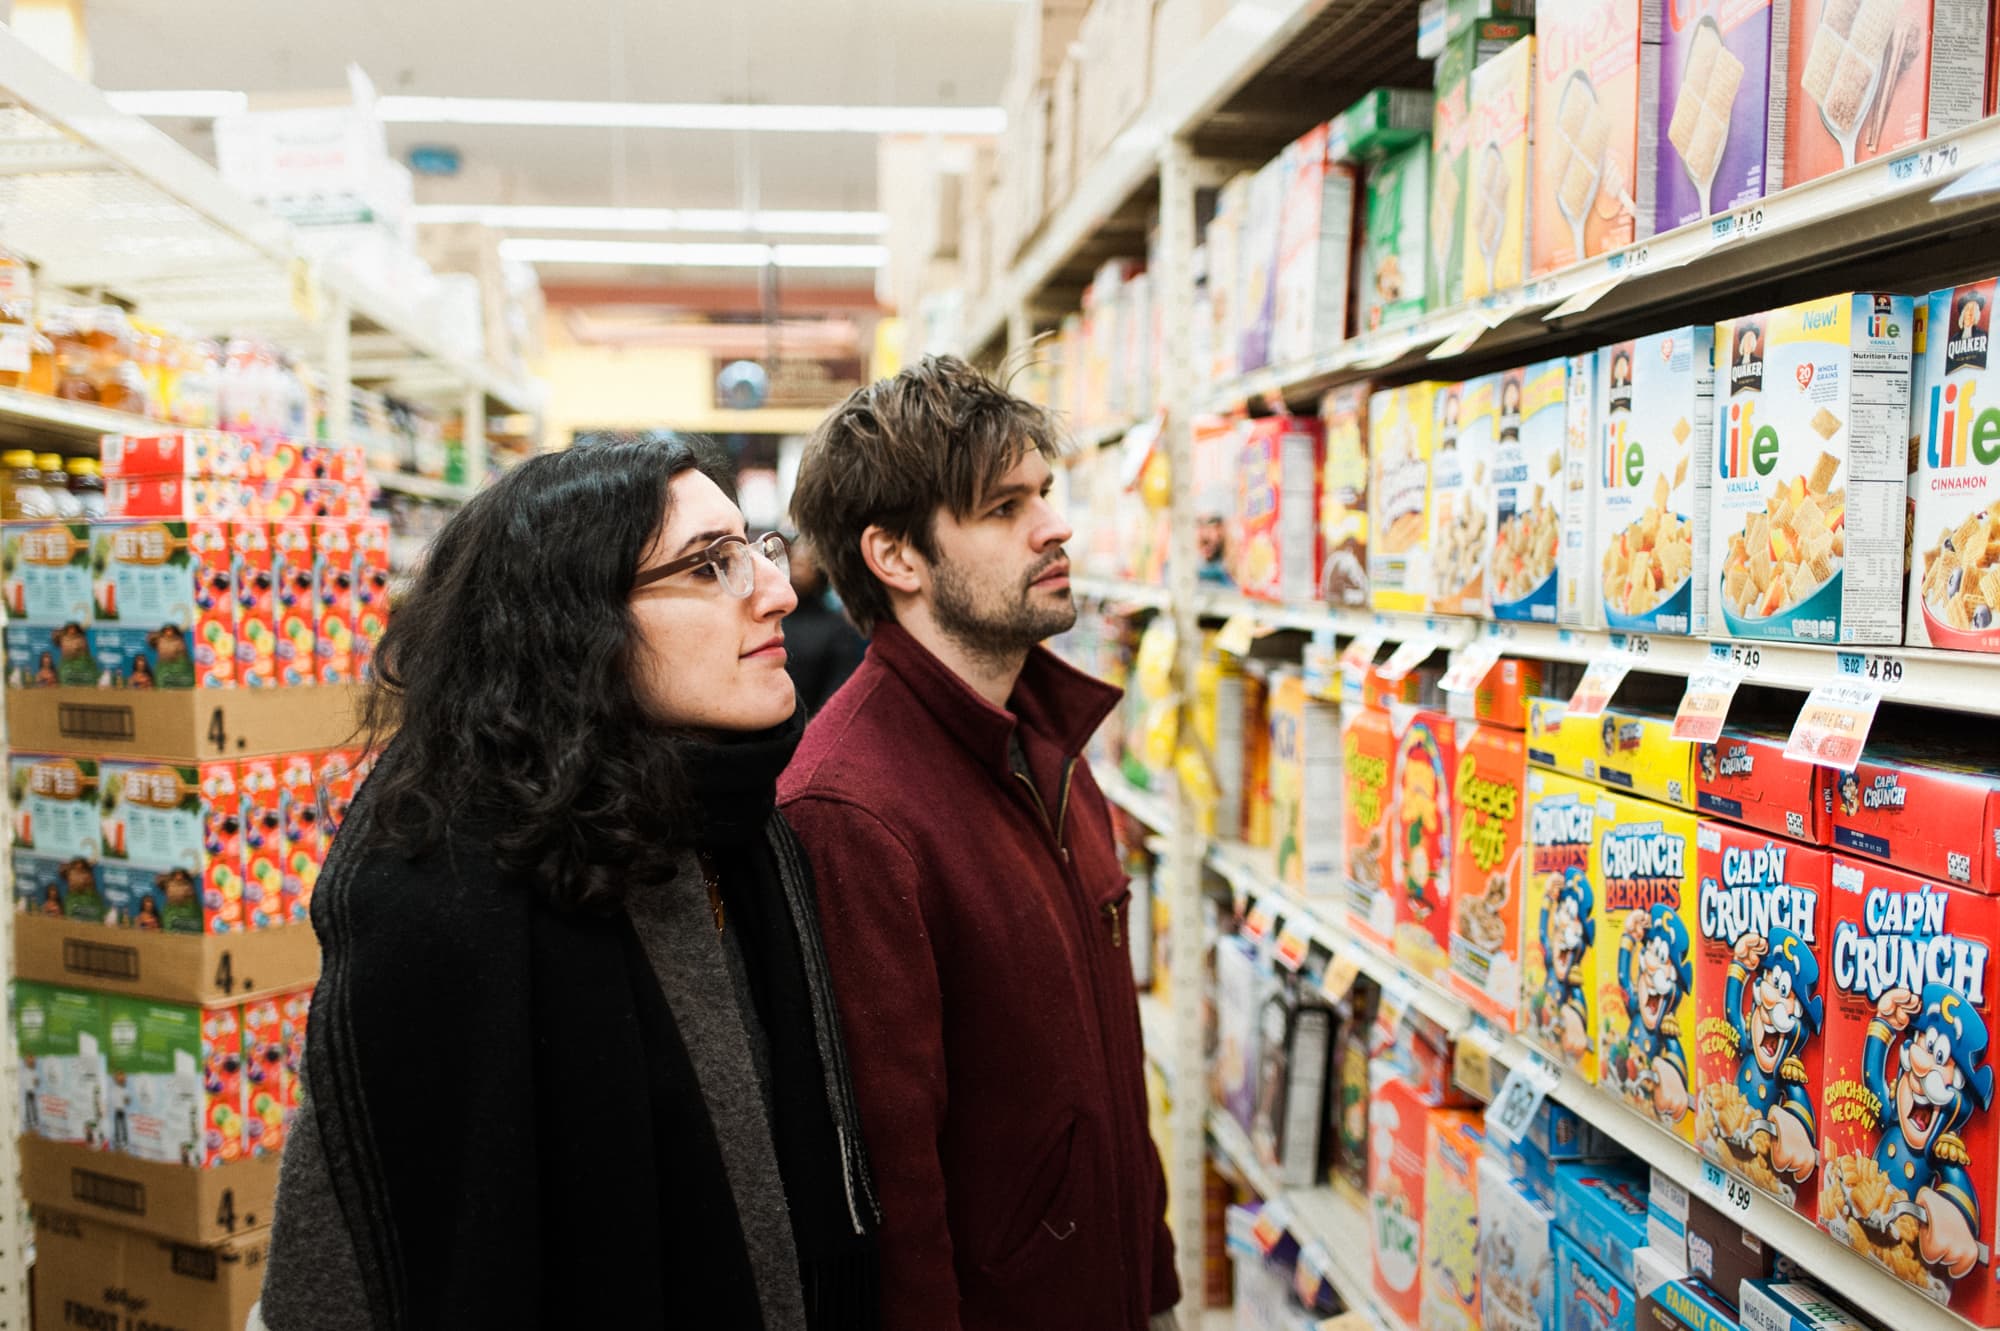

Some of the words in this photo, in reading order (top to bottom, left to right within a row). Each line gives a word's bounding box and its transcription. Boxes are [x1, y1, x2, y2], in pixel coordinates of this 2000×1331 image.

[1803, 304, 1838, 331] New!
[1868, 316, 1900, 338] life
[1948, 336, 1987, 360] QUAKER
[1731, 361, 1763, 383] QUAKER
[1719, 400, 1779, 479] life
[1927, 379, 2000, 469] life
[1602, 420, 1644, 488] life
[1727, 481, 1760, 493] VANILLA
[1931, 476, 1988, 491] CINNAMON
[1720, 755, 1754, 776] CRUNCH
[1863, 786, 1906, 809] CRUNCH
[1602, 831, 1685, 879] CRUNCH
[1722, 841, 1787, 889] CAP'N
[1605, 877, 1681, 912] BERRIES
[1865, 883, 1948, 936] CAP'N
[1700, 877, 1818, 947] CRUNCH
[1834, 921, 1989, 1004] CRUNCH
[1702, 1037, 1714, 1056] ME
[1831, 1106, 1844, 1124] ME
[1843, 1101, 1876, 1132] CAP'N!
[1666, 1285, 1708, 1331] FAMILY
[1744, 1300, 1765, 1328] WHOLE
